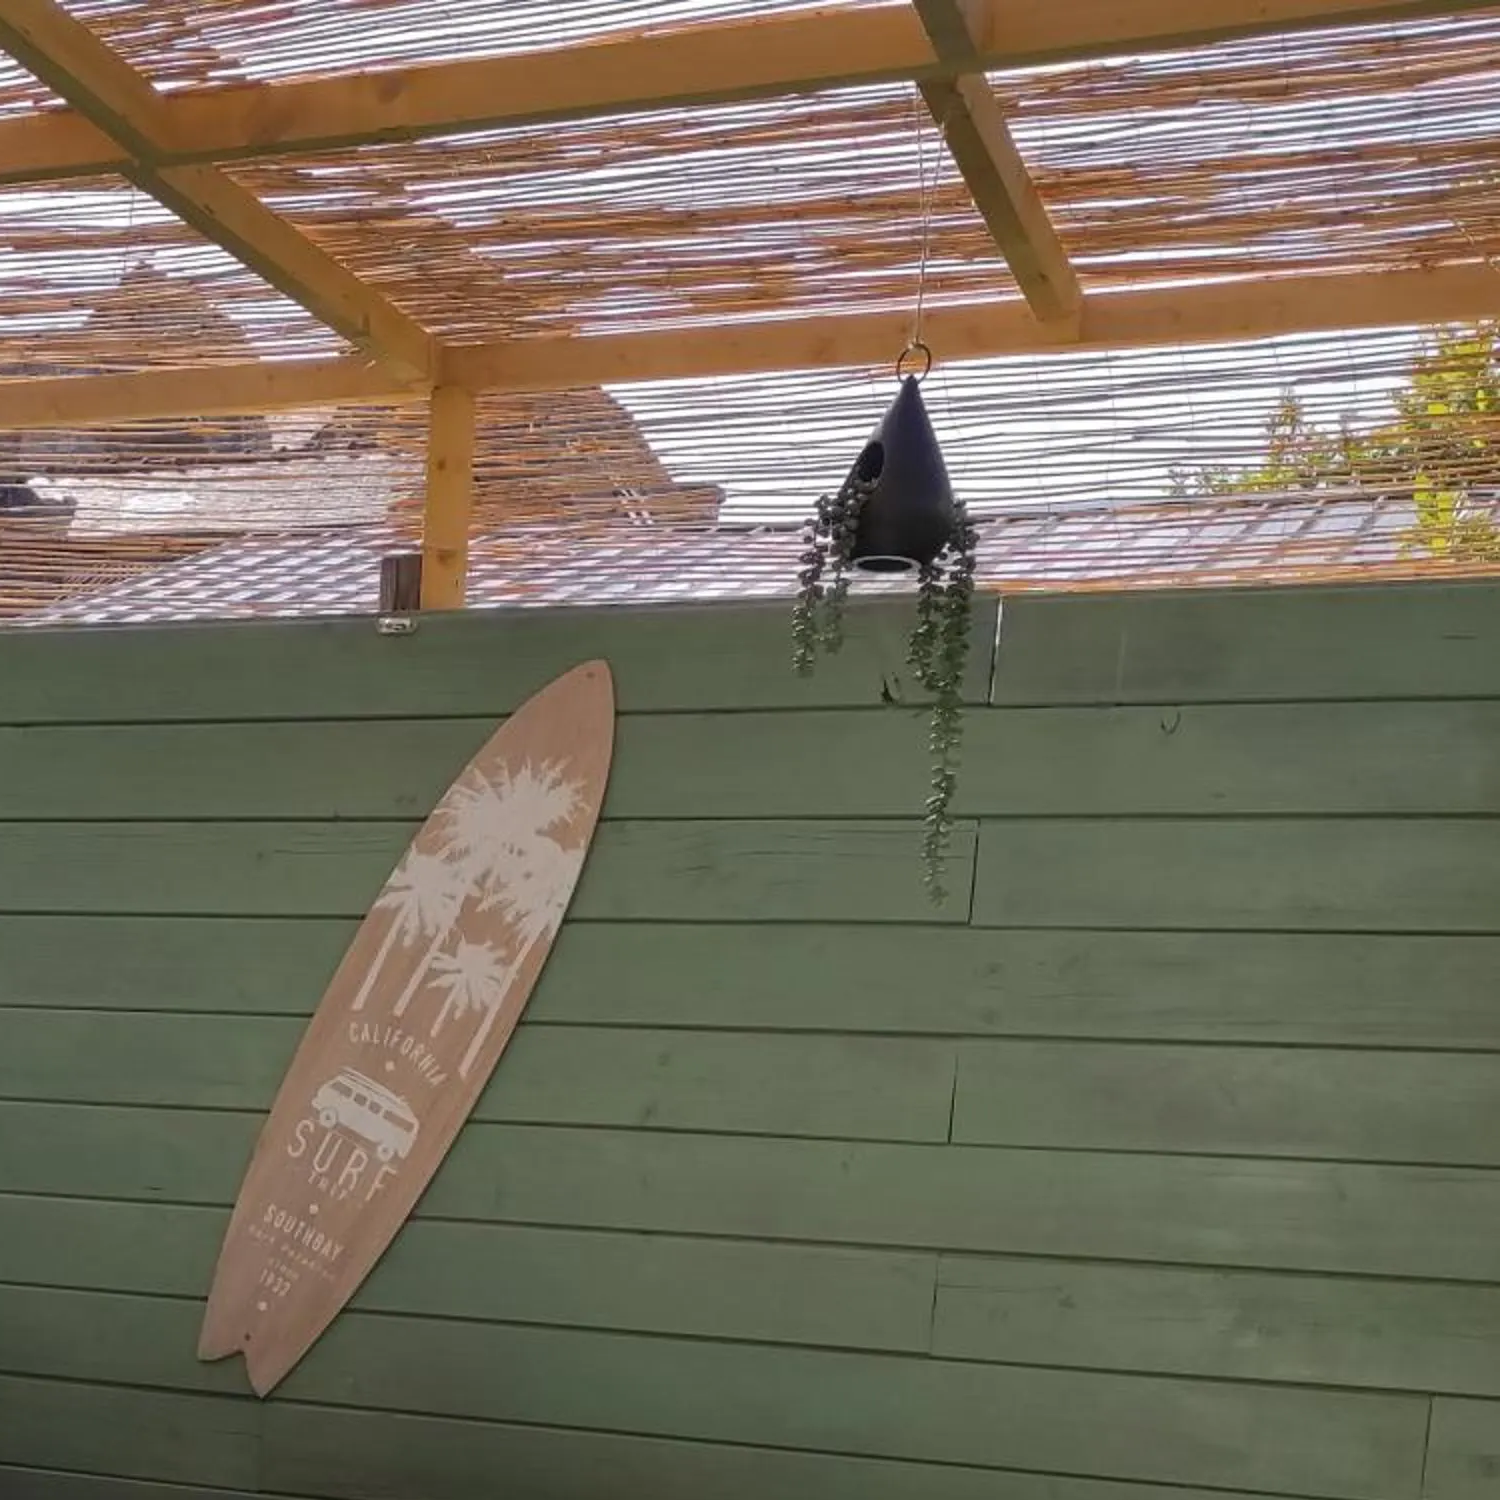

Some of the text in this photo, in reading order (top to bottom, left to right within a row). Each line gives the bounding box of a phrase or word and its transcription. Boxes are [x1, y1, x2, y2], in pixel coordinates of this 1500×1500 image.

[349, 1021, 449, 1089] CALIFORNIA
[287, 1119, 397, 1201] SURF
[263, 1203, 345, 1261] SOUTHBAY
